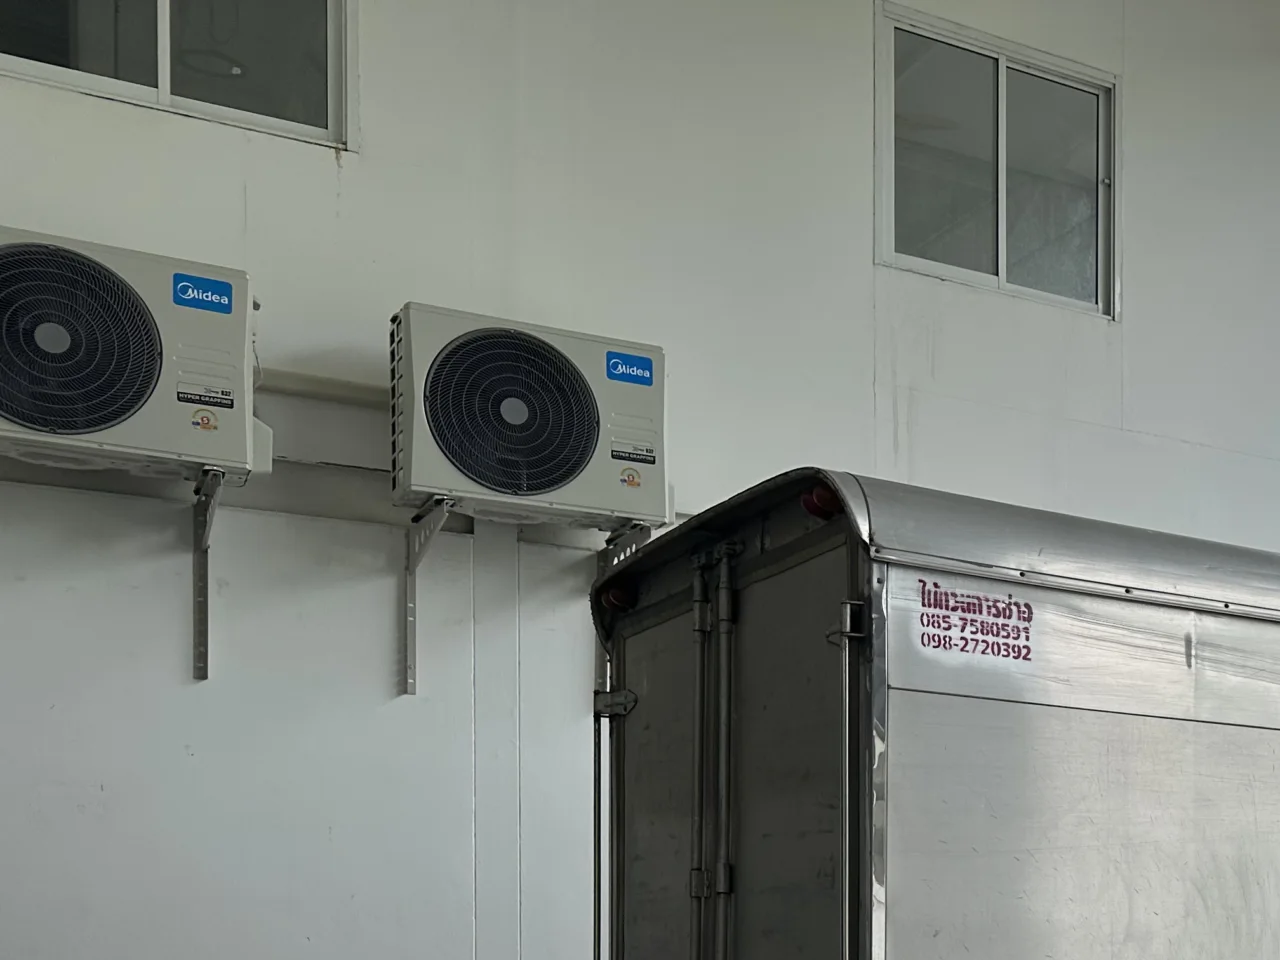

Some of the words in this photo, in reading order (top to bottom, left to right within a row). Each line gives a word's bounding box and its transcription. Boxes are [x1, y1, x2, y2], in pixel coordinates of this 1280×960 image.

[177, 282, 229, 305] Midea
[610, 359, 650, 378] Midea
[921, 632, 1032, 661] 098-2720392
